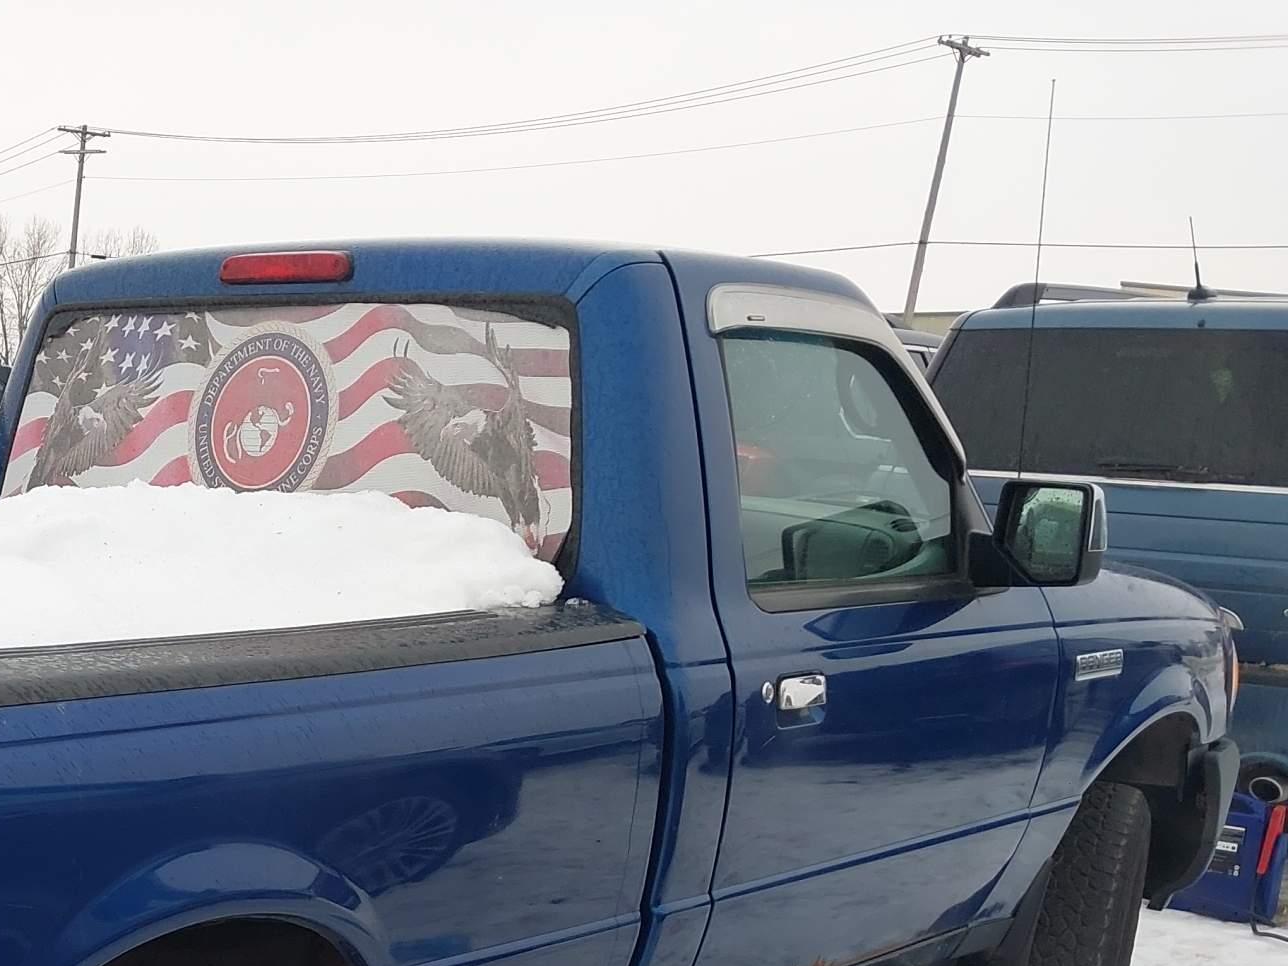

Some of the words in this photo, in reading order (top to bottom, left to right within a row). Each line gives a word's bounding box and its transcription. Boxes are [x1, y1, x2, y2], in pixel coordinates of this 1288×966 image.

[204, 338, 272, 406] DEPARTMENT
[273, 338, 290, 352] OF
[291, 343, 312, 368] THE
[306, 363, 326, 404] NAVY
[198, 423, 215, 478] UNITED
[297, 426, 323, 475] CORPS
